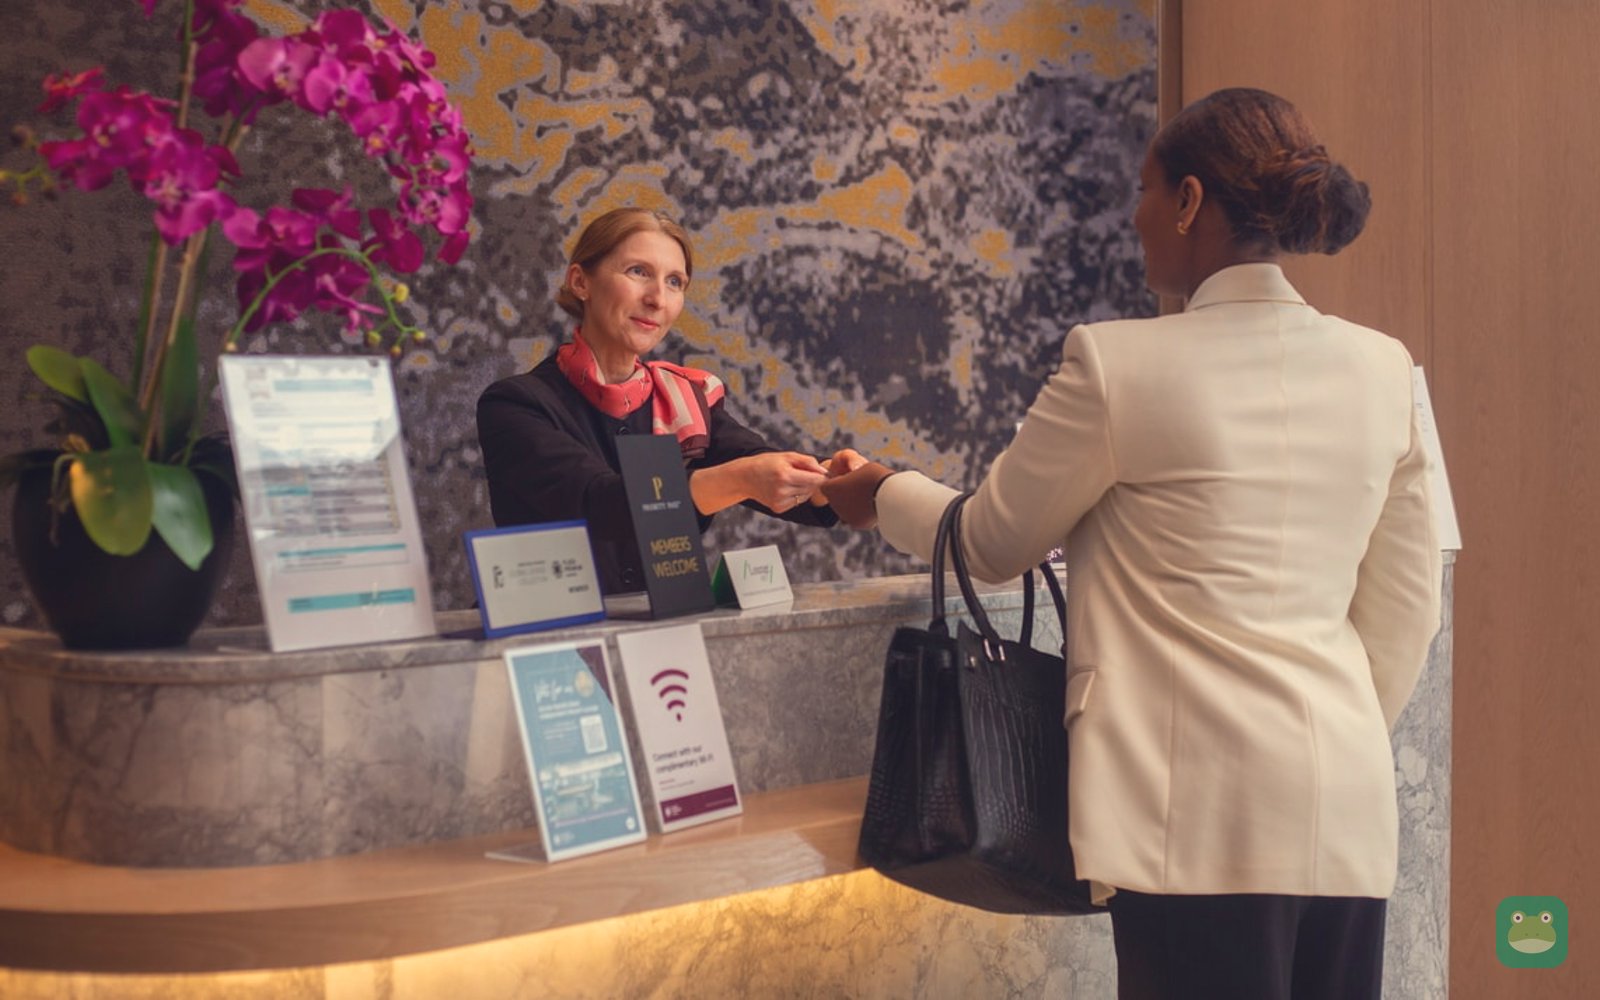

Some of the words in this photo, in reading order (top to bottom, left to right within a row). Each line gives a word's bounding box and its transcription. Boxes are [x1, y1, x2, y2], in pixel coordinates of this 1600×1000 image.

[652, 476, 663, 500] P
[650, 536, 692, 555] MEMBERS
[652, 557, 699, 578] WELCOME
